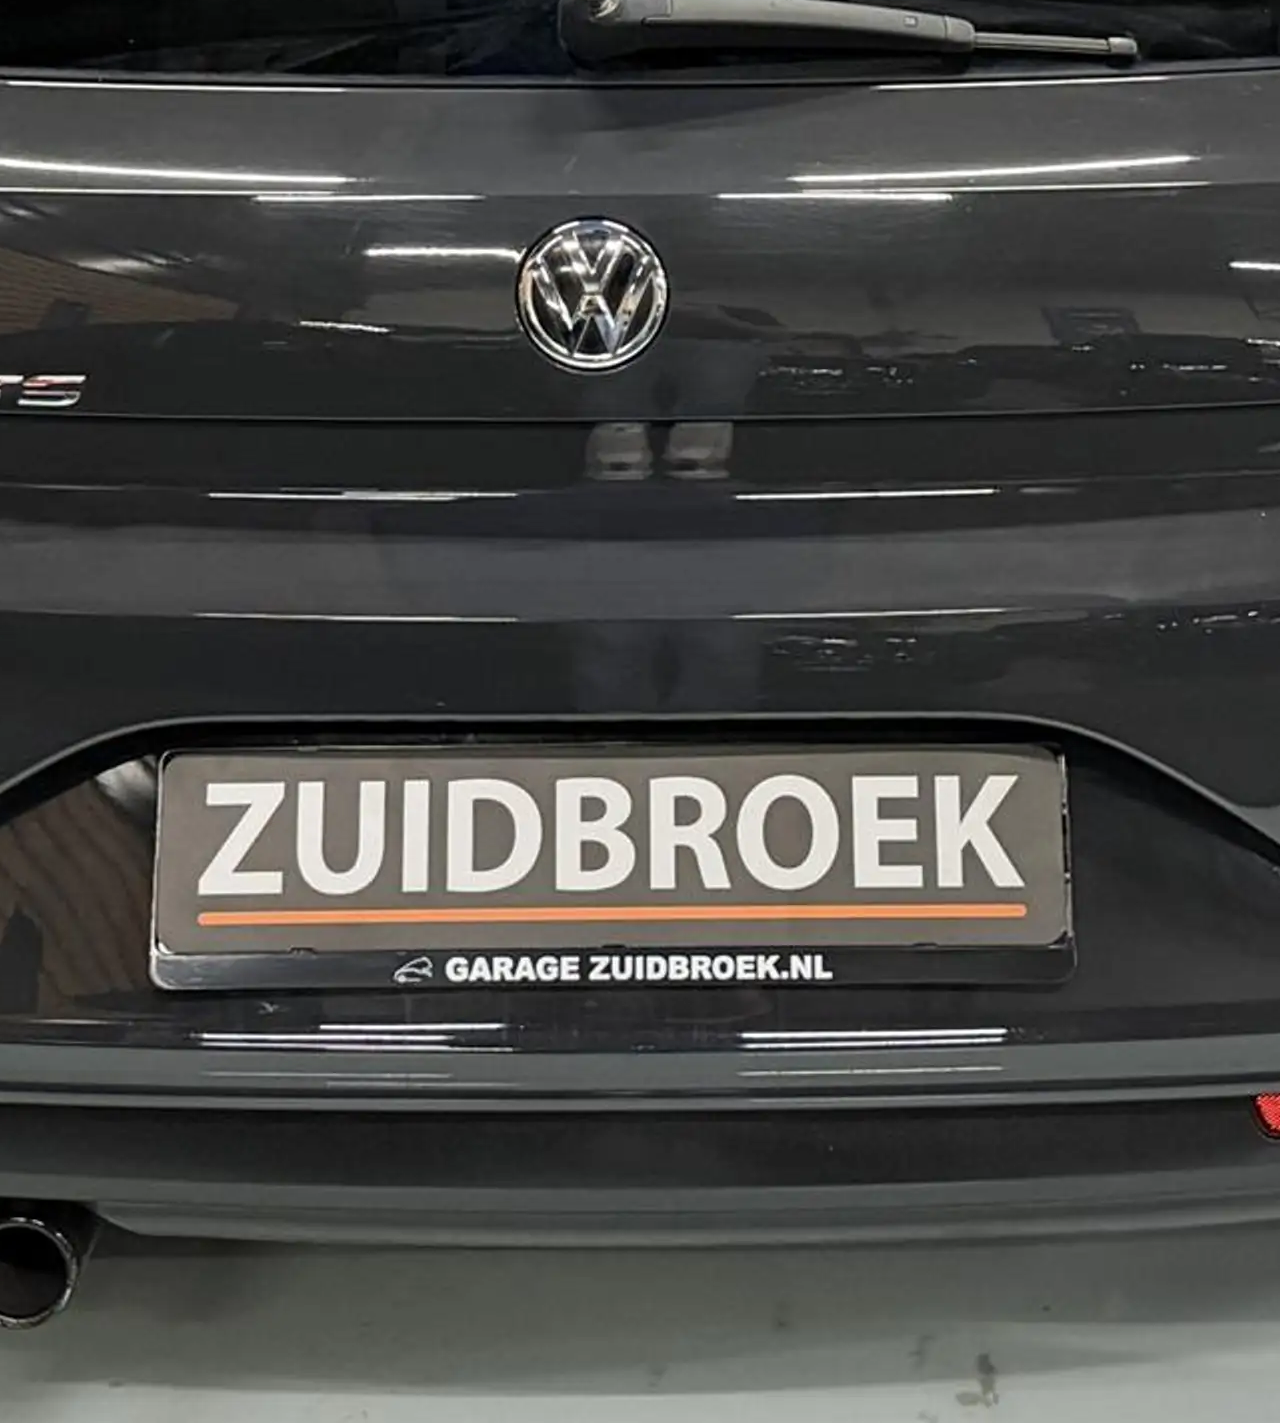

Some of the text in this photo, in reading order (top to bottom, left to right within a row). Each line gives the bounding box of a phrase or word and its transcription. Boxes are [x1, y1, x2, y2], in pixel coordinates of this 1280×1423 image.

[196, 774, 1026, 897] ZUIDBROEK
[445, 953, 833, 982] GARAGE ZUIDBROEK.NL
